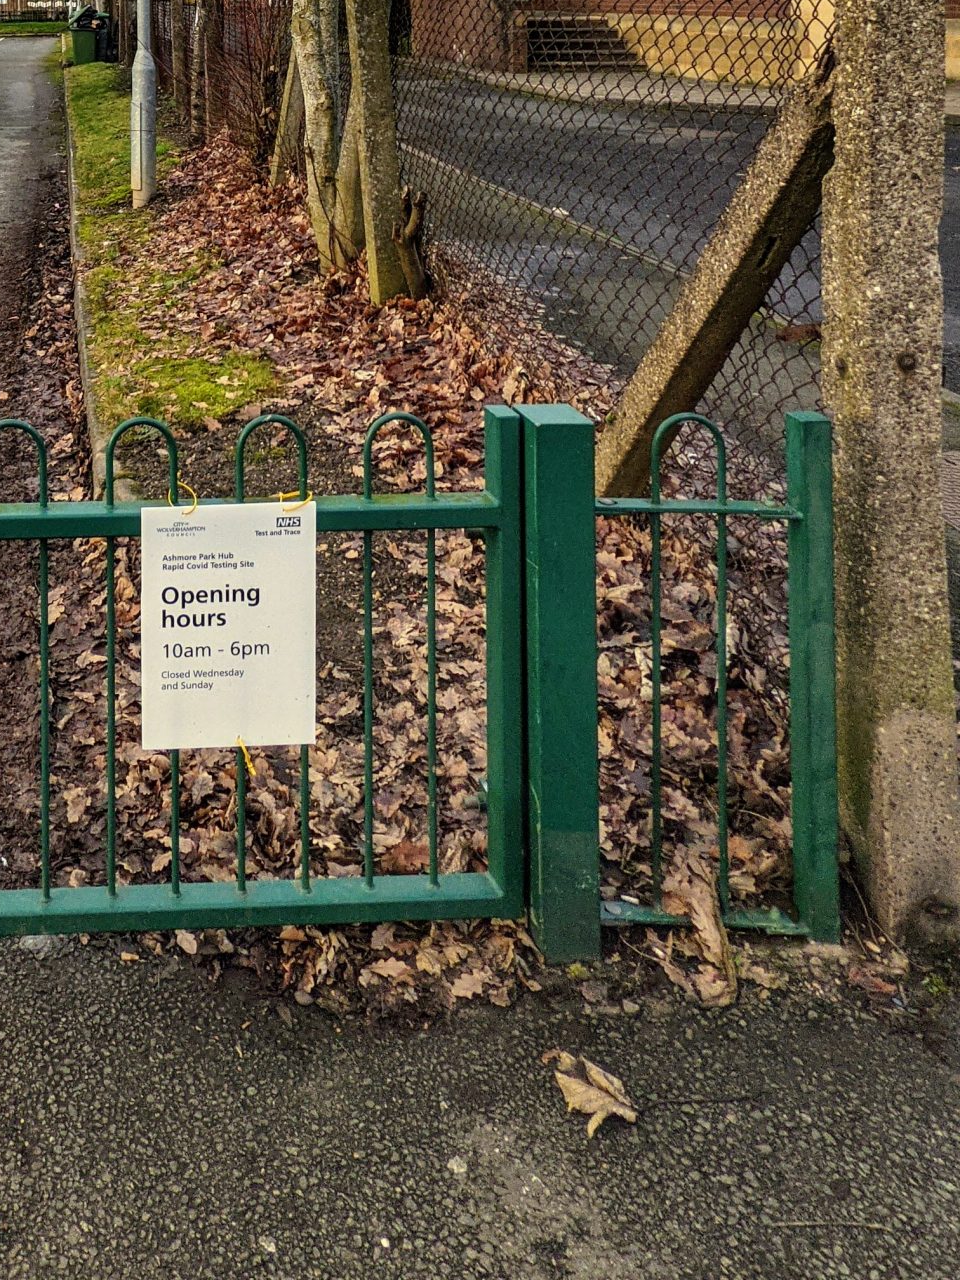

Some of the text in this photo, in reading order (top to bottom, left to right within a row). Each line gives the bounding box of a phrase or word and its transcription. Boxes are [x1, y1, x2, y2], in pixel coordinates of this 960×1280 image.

[276, 517, 301, 527] NHS
[163, 560, 254, 571] Rapid Covid Testing Site
[161, 584, 260, 608] Opening
[162, 610, 226, 628] hours
[162, 643, 212, 658] 10am
[230, 641, 270, 659] 6pm
[161, 668, 244, 679] Closed Wednesday
[161, 680, 213, 690] and Sunday
